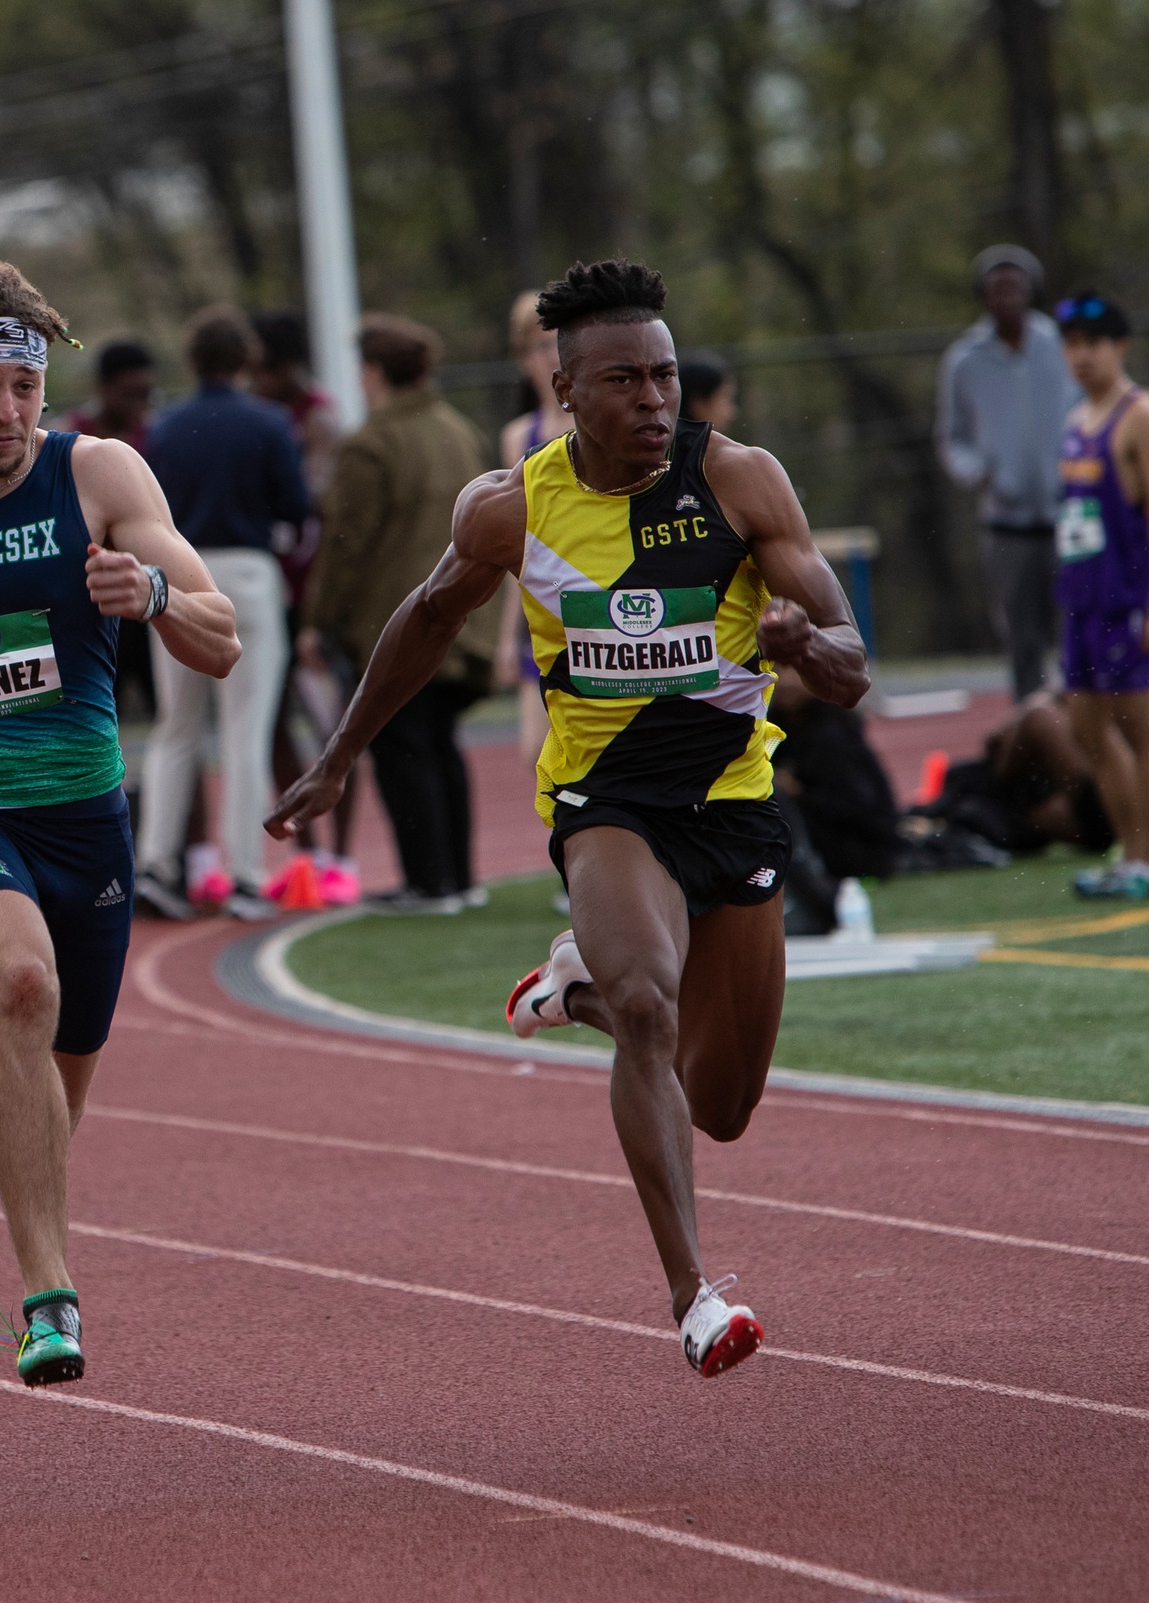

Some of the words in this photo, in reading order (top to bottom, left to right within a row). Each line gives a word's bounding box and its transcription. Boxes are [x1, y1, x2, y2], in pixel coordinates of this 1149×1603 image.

[640, 516, 709, 549] GSTC
[570, 635, 714, 671] FITZGERALD
[590, 680, 622, 688] MIDDLESEX
[654, 677, 697, 687] INVITATIONAL
[94, 893, 126, 907] adidas
